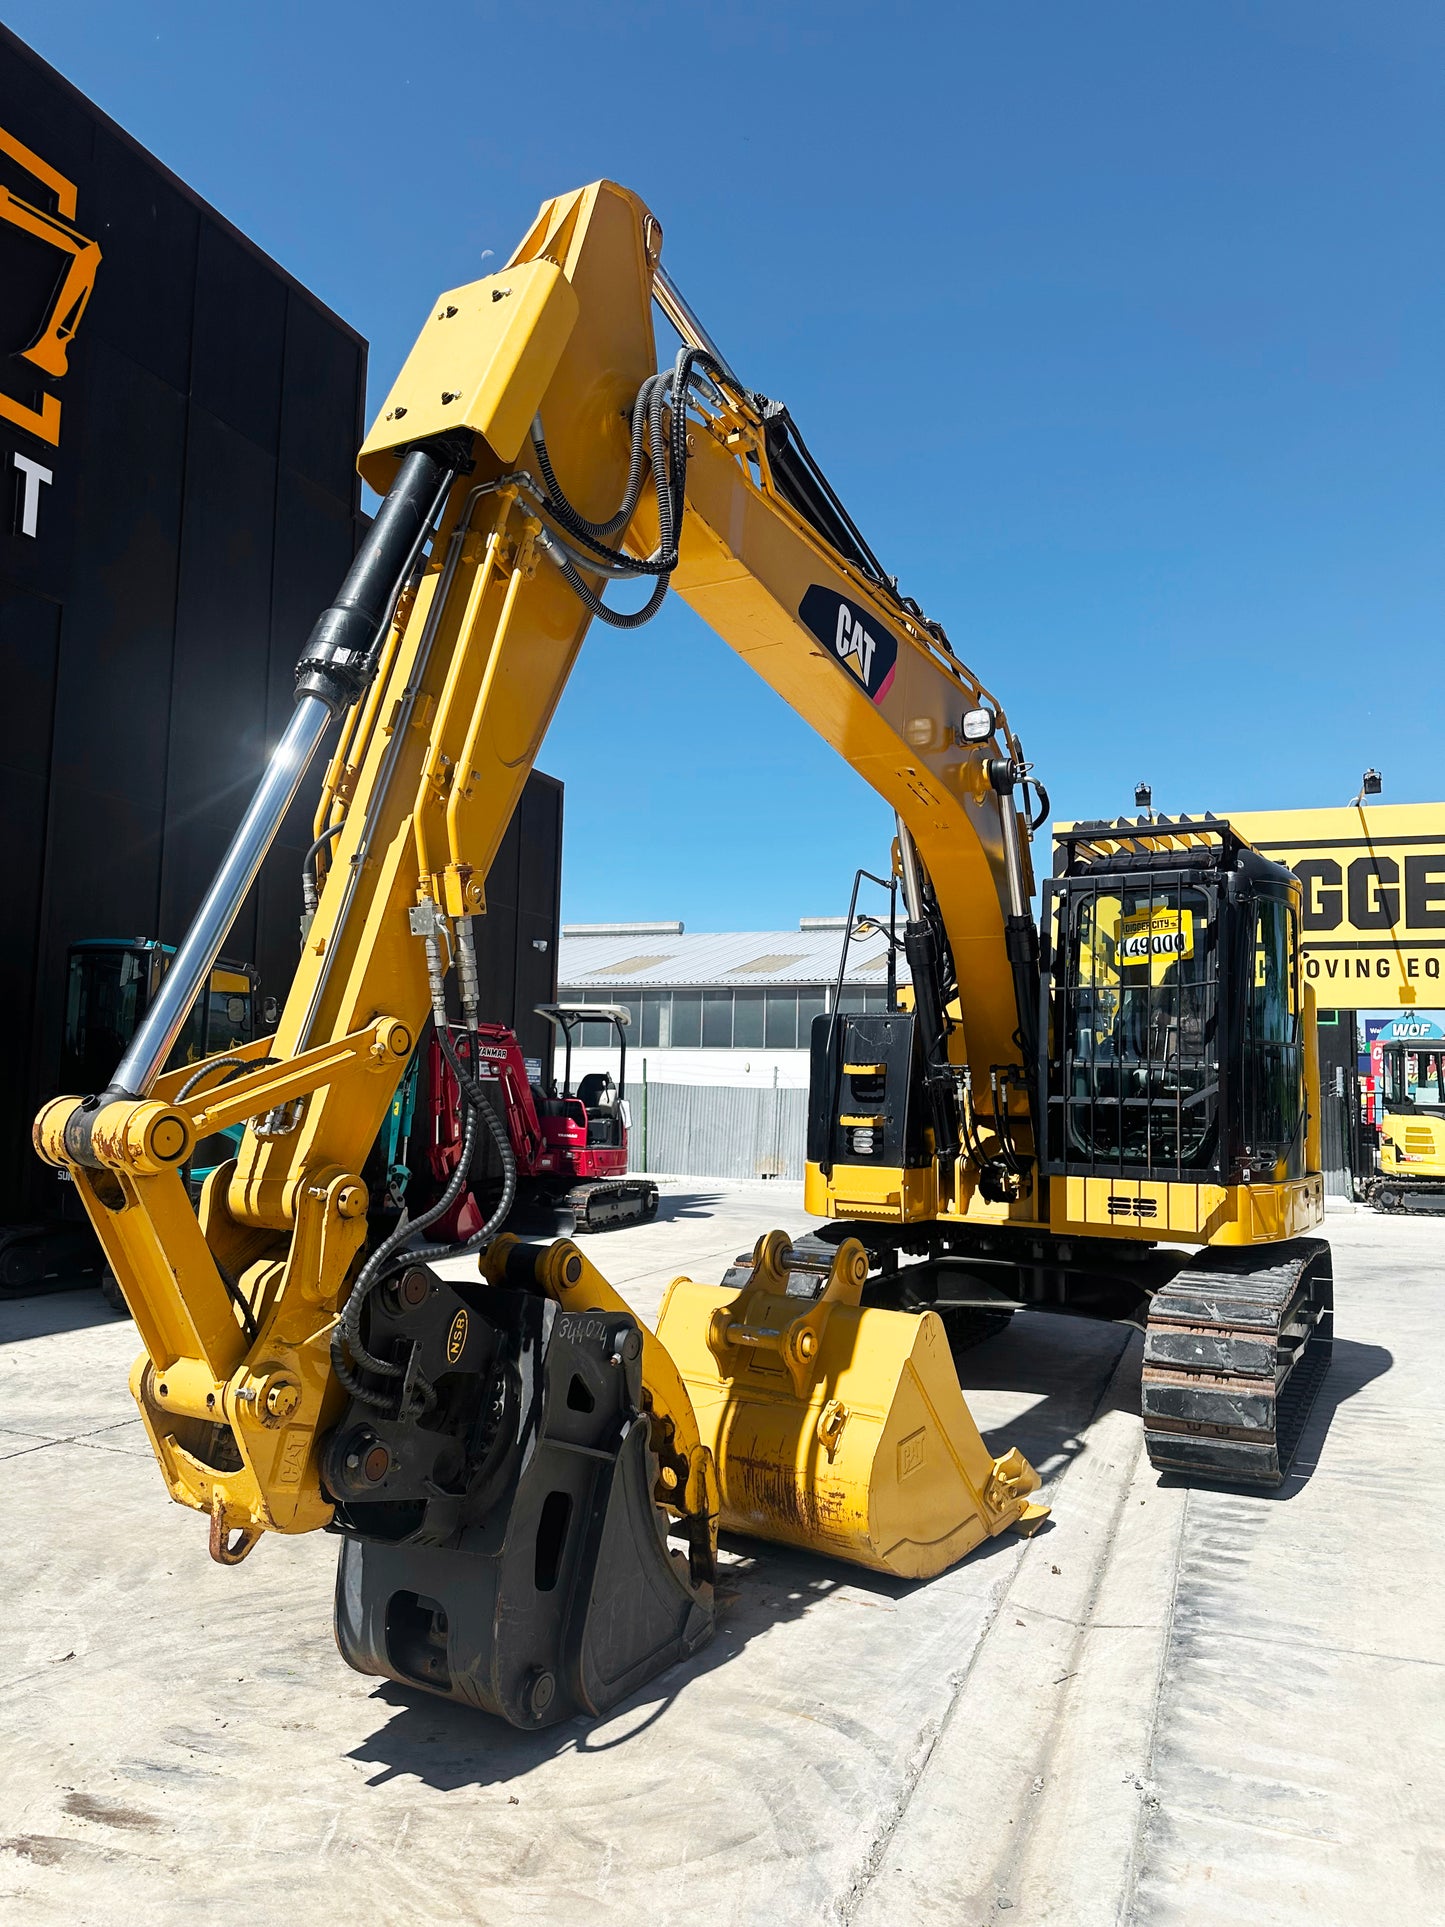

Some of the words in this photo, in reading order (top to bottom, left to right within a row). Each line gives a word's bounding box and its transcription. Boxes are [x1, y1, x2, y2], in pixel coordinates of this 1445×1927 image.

[836, 604, 876, 687] CAT
[1292, 855, 1445, 931] GGE
[1152, 919, 1169, 929] CITY
[1306, 958, 1390, 979] OVING
[1407, 957, 1440, 979] EQ
[1392, 1023, 1431, 1037] WOF
[57, 1170, 74, 1181] SUN
